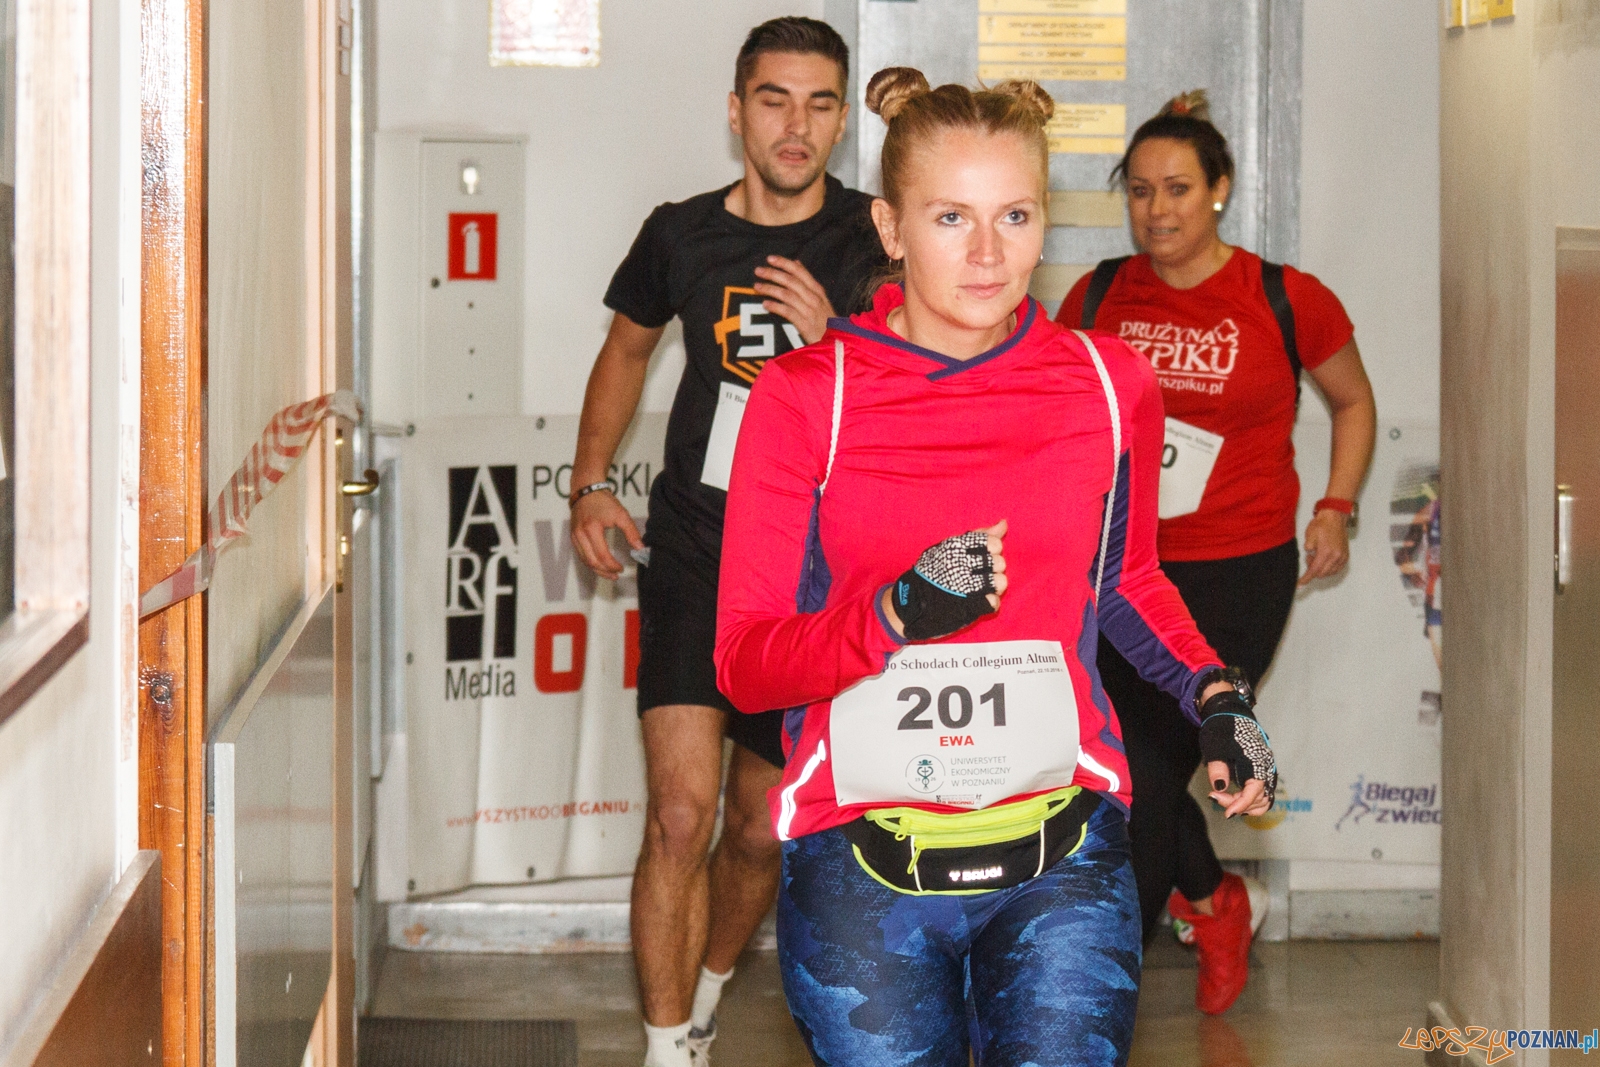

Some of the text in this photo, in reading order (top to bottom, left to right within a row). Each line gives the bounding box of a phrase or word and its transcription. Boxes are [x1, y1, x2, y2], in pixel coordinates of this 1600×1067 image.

[1119, 321, 1216, 344] DRUŻYNA
[1127, 340, 1239, 375] ZPIKU
[533, 464, 651, 499] POSKI
[901, 657, 959, 670] Schodach
[962, 655, 1023, 669] Collegium
[1026, 653, 1058, 664] Altum
[446, 665, 516, 700] Media
[897, 683, 1006, 730] 201
[939, 735, 974, 747] EWA
[950, 756, 1007, 766] UNIWERSYTET
[951, 767, 1012, 777] EKONOMICZNY
[962, 778, 1006, 787] POZNANIU
[1366, 783, 1437, 808] Biegaj
